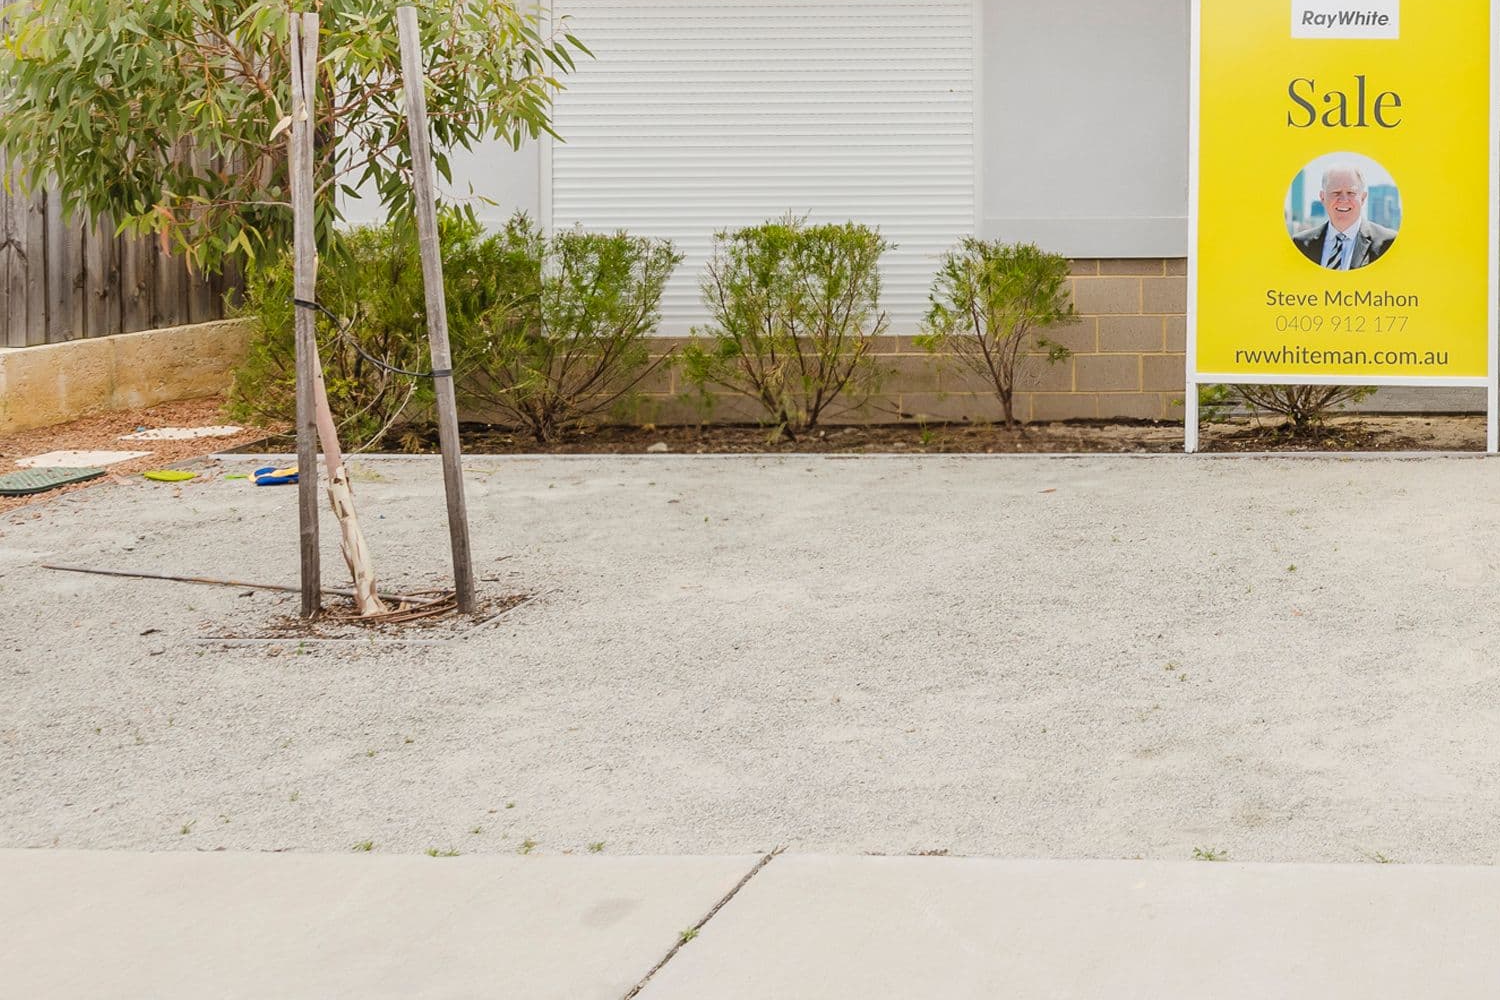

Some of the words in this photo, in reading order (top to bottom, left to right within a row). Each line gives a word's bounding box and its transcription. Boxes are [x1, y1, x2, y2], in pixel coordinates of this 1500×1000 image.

[1287, 74, 1402, 129] Sale
[1266, 289, 1318, 307] Steve
[1324, 290, 1419, 307] McMahon
[1275, 315, 1324, 333] 0409
[1330, 315, 1366, 333] 912
[1374, 316, 1409, 333] 177
[1235, 345, 1448, 366] rwwhiteman.com.au
